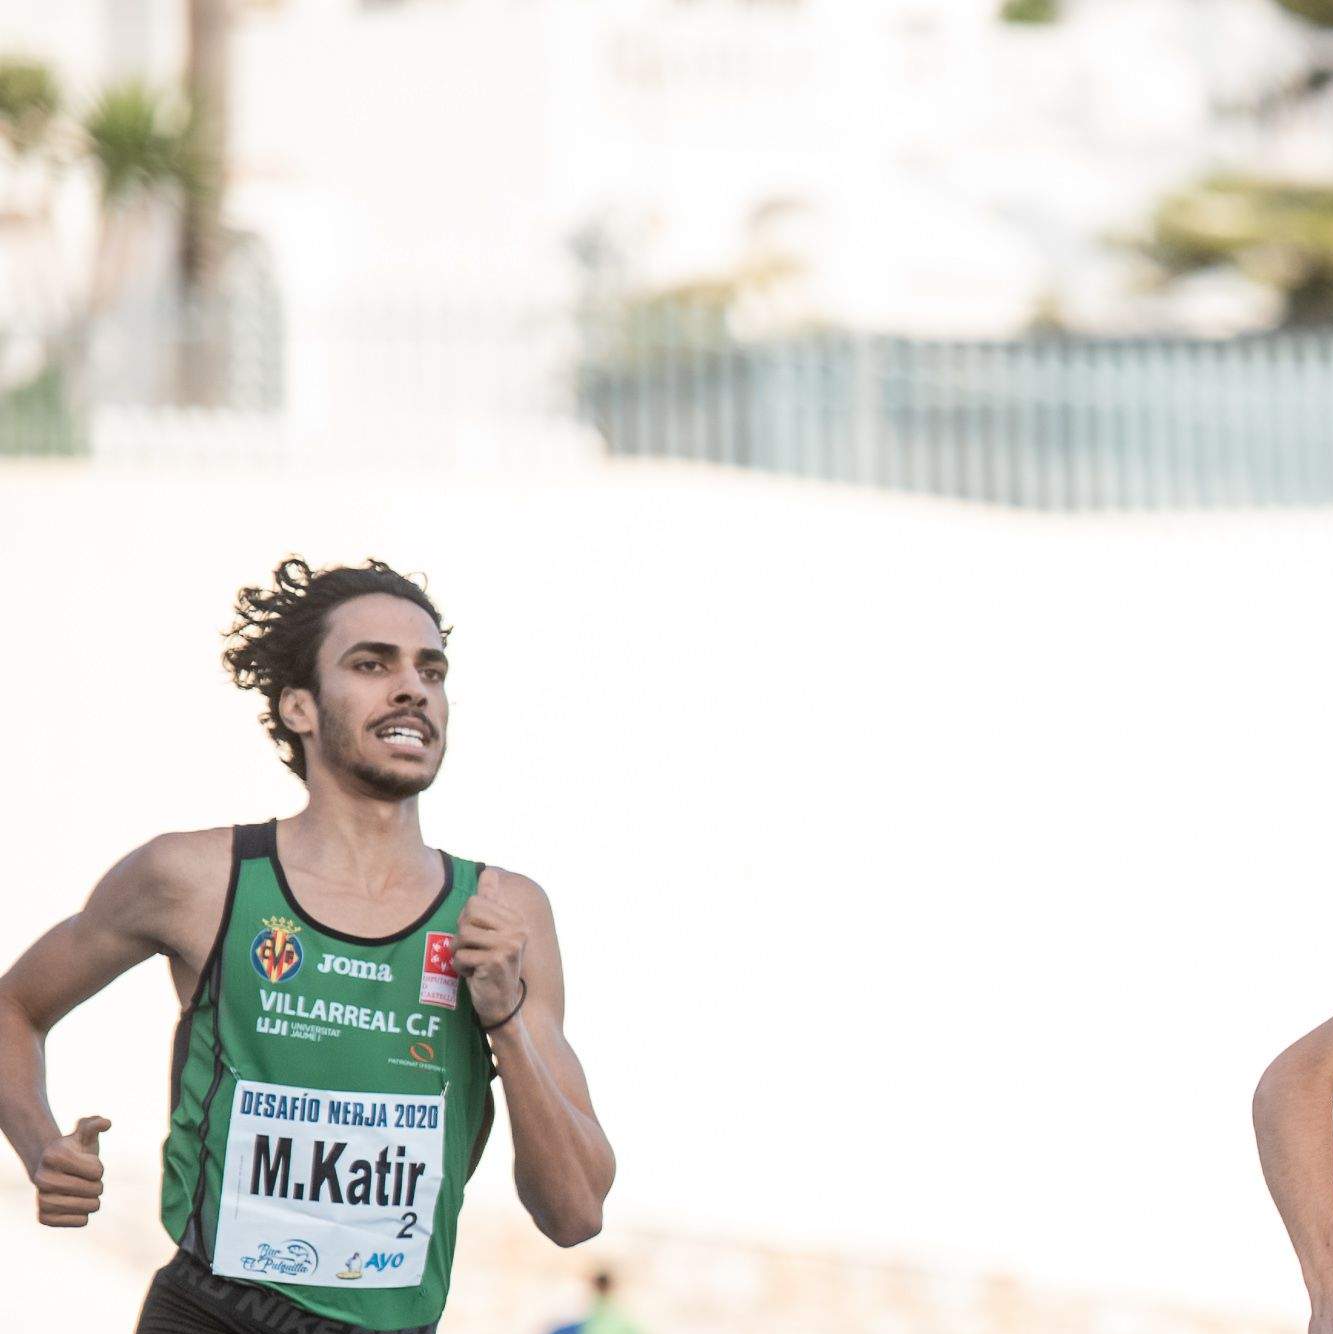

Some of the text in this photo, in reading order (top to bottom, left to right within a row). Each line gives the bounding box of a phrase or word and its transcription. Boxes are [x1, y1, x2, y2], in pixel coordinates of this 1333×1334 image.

[317, 953, 394, 983] Joma
[260, 989, 441, 1038] VILLARREAL C.F
[256, 1016, 289, 1036] UJI
[290, 1031, 316, 1041] JAUME
[291, 1022, 341, 1037] UNIVERSITAT
[240, 1090, 438, 1129] DESAFÍO NERJA 2020
[250, 1134, 426, 1207] M.Katir
[396, 1212, 418, 1239] 2
[258, 1243, 281, 1258] Bar
[364, 1252, 405, 1272] AYO
